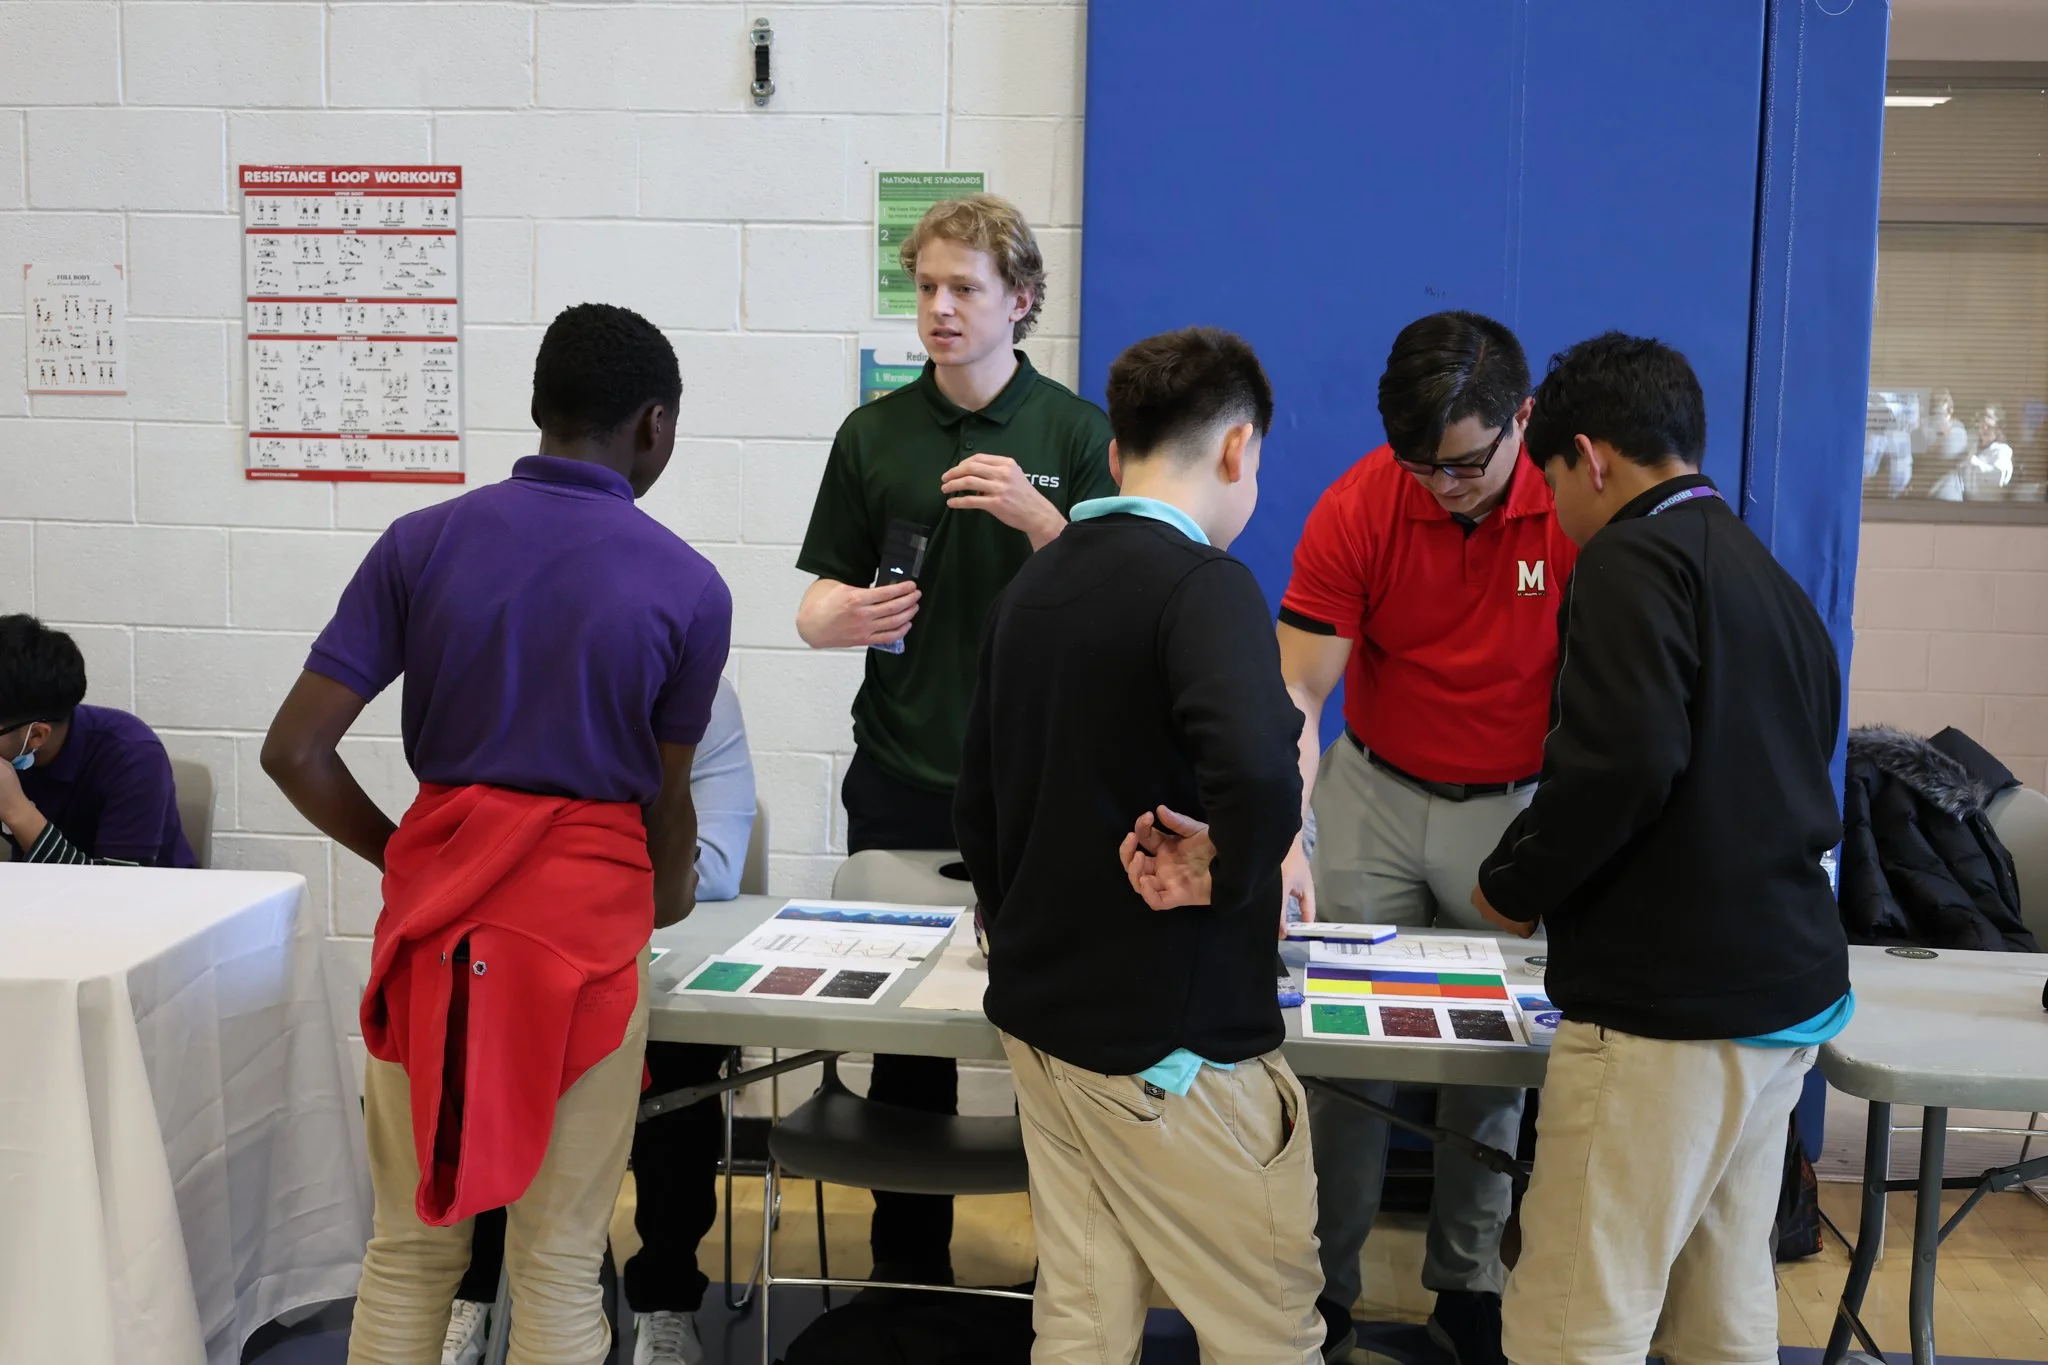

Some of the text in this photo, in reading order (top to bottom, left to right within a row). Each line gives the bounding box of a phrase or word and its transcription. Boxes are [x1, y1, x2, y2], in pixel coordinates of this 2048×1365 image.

[244, 171, 457, 183] RESISTANCE LOOP WORKOUTS
[882, 176, 981, 185] NATIONAL PE STANDARDS
[880, 229, 889, 240] 2
[881, 252, 889, 264] 3
[880, 275, 889, 287] 4
[880, 297, 889, 309] 5
[906, 352, 928, 361] Redir
[882, 372, 914, 384] Warning
[1025, 473, 1060, 488] res
[1517, 560, 1545, 591] M
